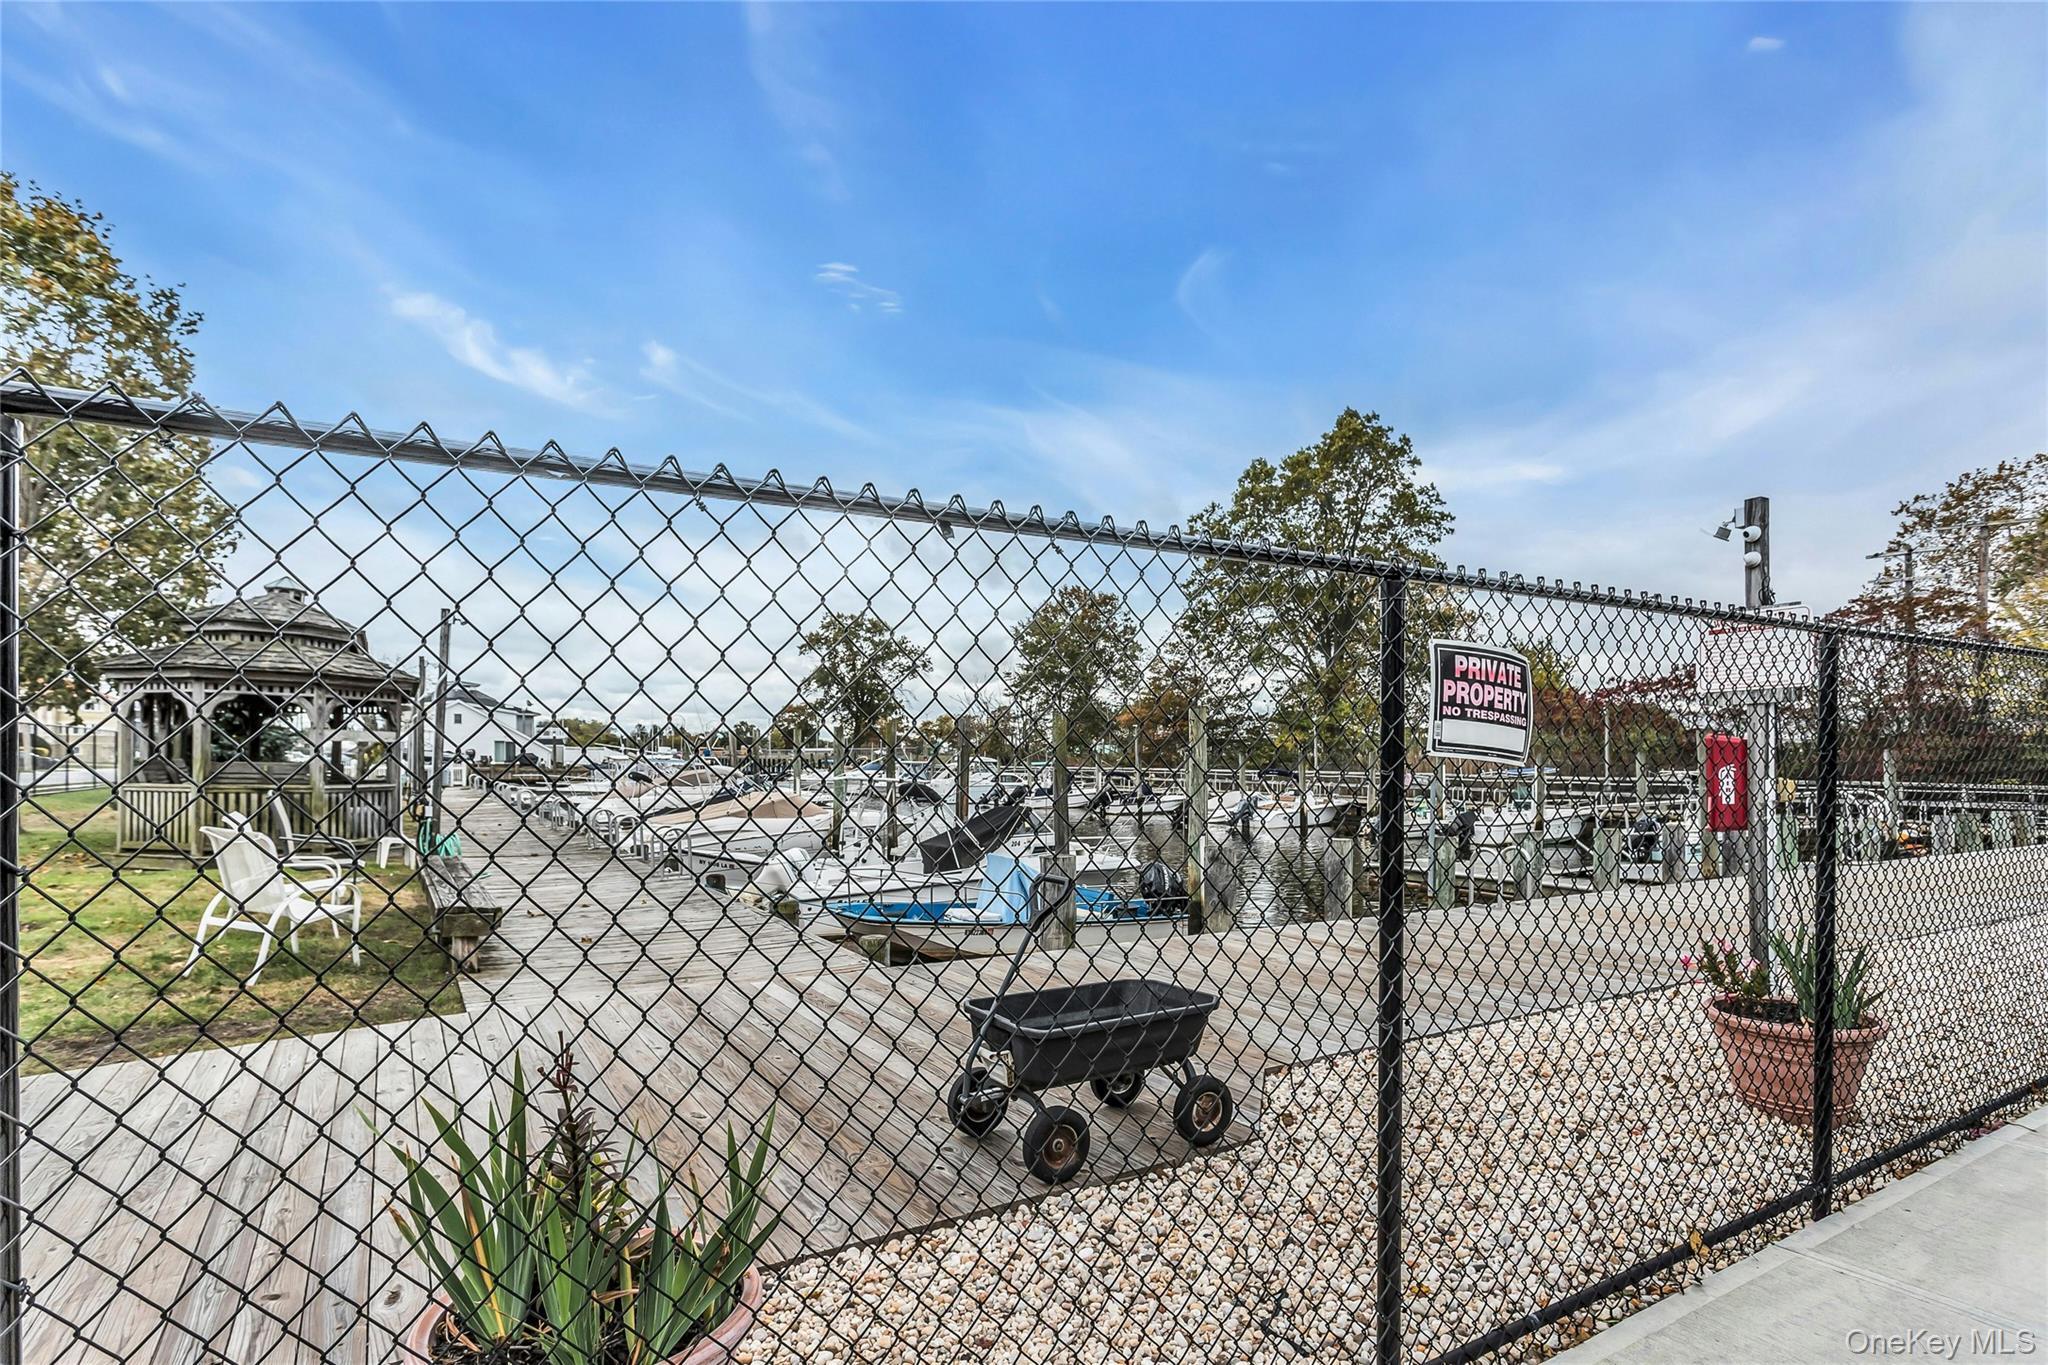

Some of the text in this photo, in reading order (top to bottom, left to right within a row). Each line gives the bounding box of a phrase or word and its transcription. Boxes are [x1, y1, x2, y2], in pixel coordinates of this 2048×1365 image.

[1454, 654, 1521, 689] PRIVATE
[1443, 679, 1527, 714] PROPERTY
[1442, 706, 1527, 727] NO TRESPASSING
